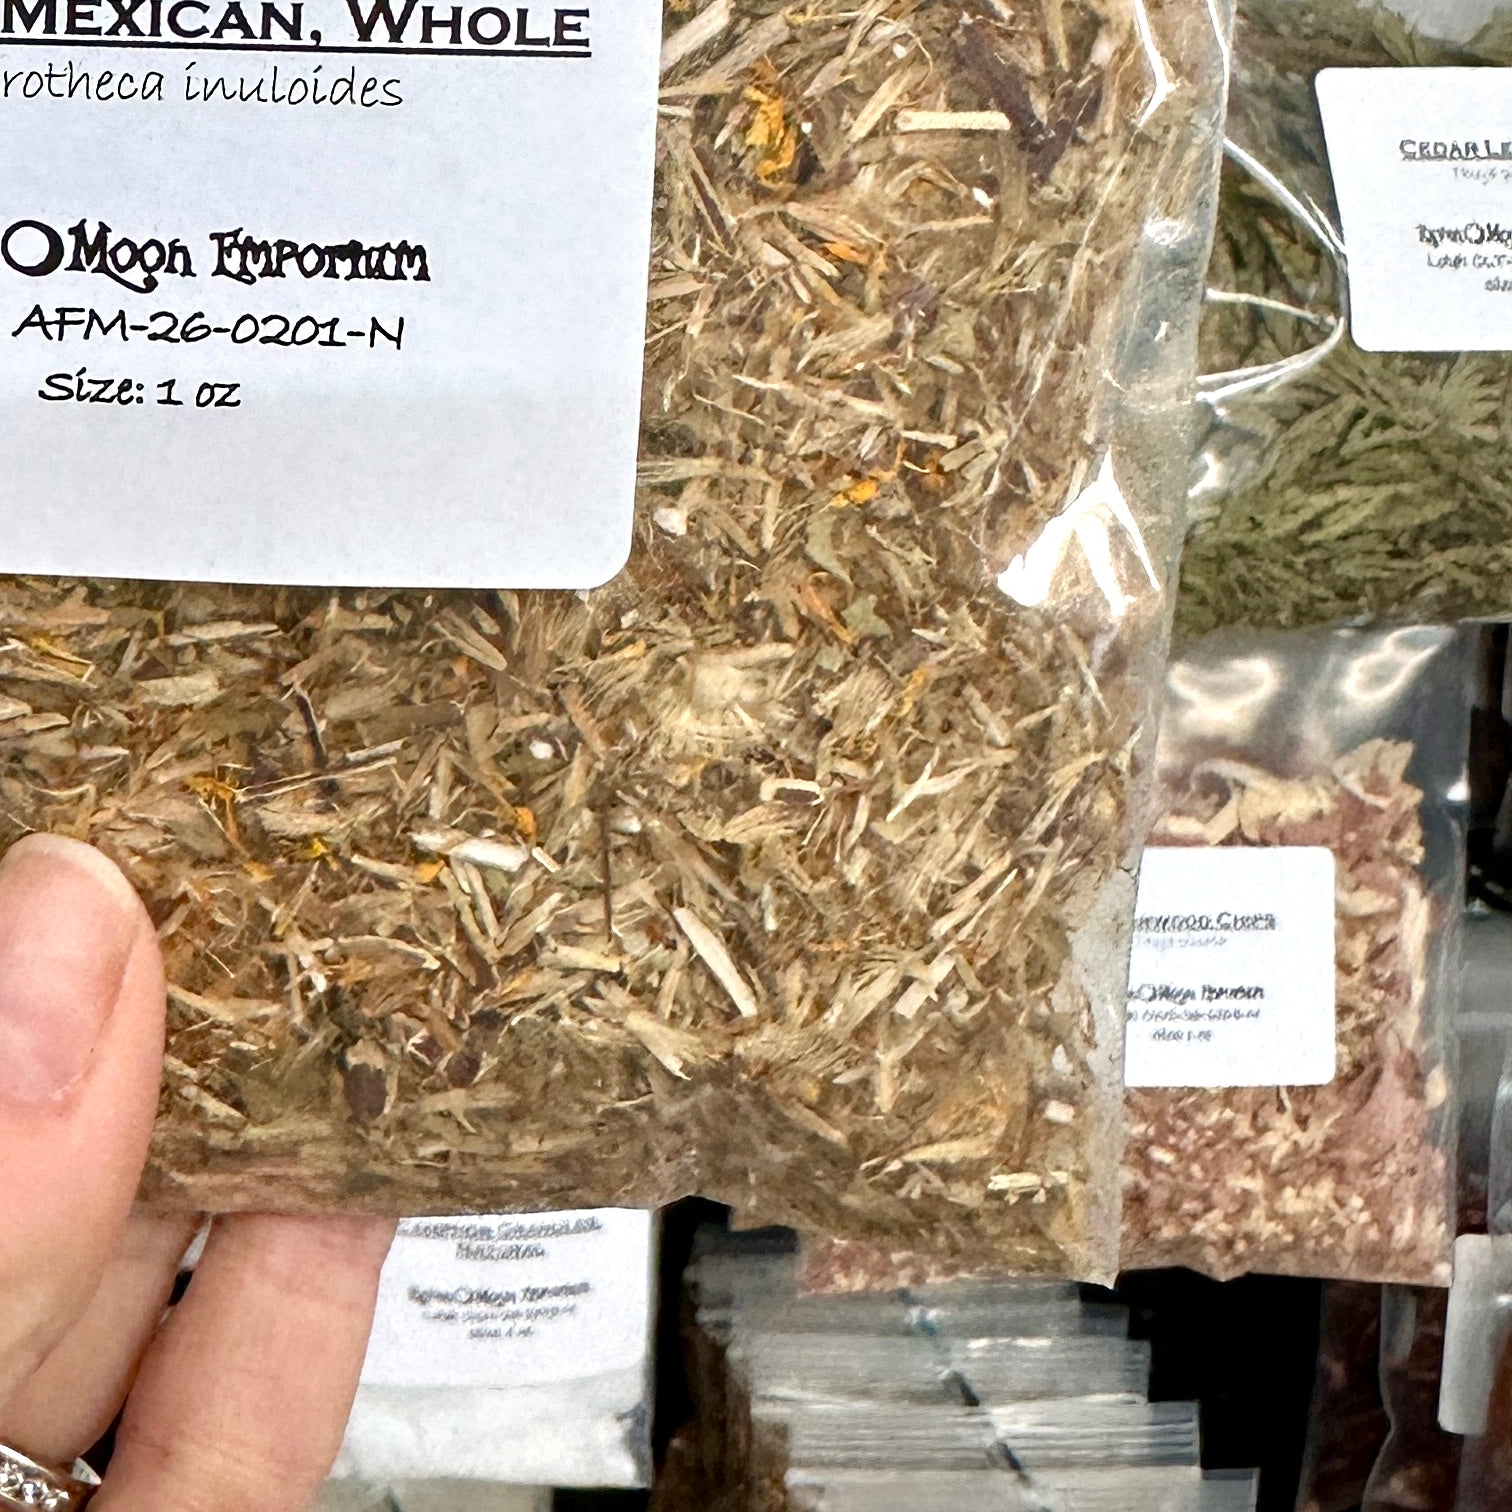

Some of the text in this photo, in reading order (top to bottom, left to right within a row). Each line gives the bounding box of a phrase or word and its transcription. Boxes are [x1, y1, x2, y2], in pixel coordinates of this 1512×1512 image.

[184, 61, 404, 108] inuloides
[207, 225, 432, 286] Emporium
[11, 303, 405, 351] AFM-26-0201-N
[37, 366, 243, 408] Size: 1 oz
